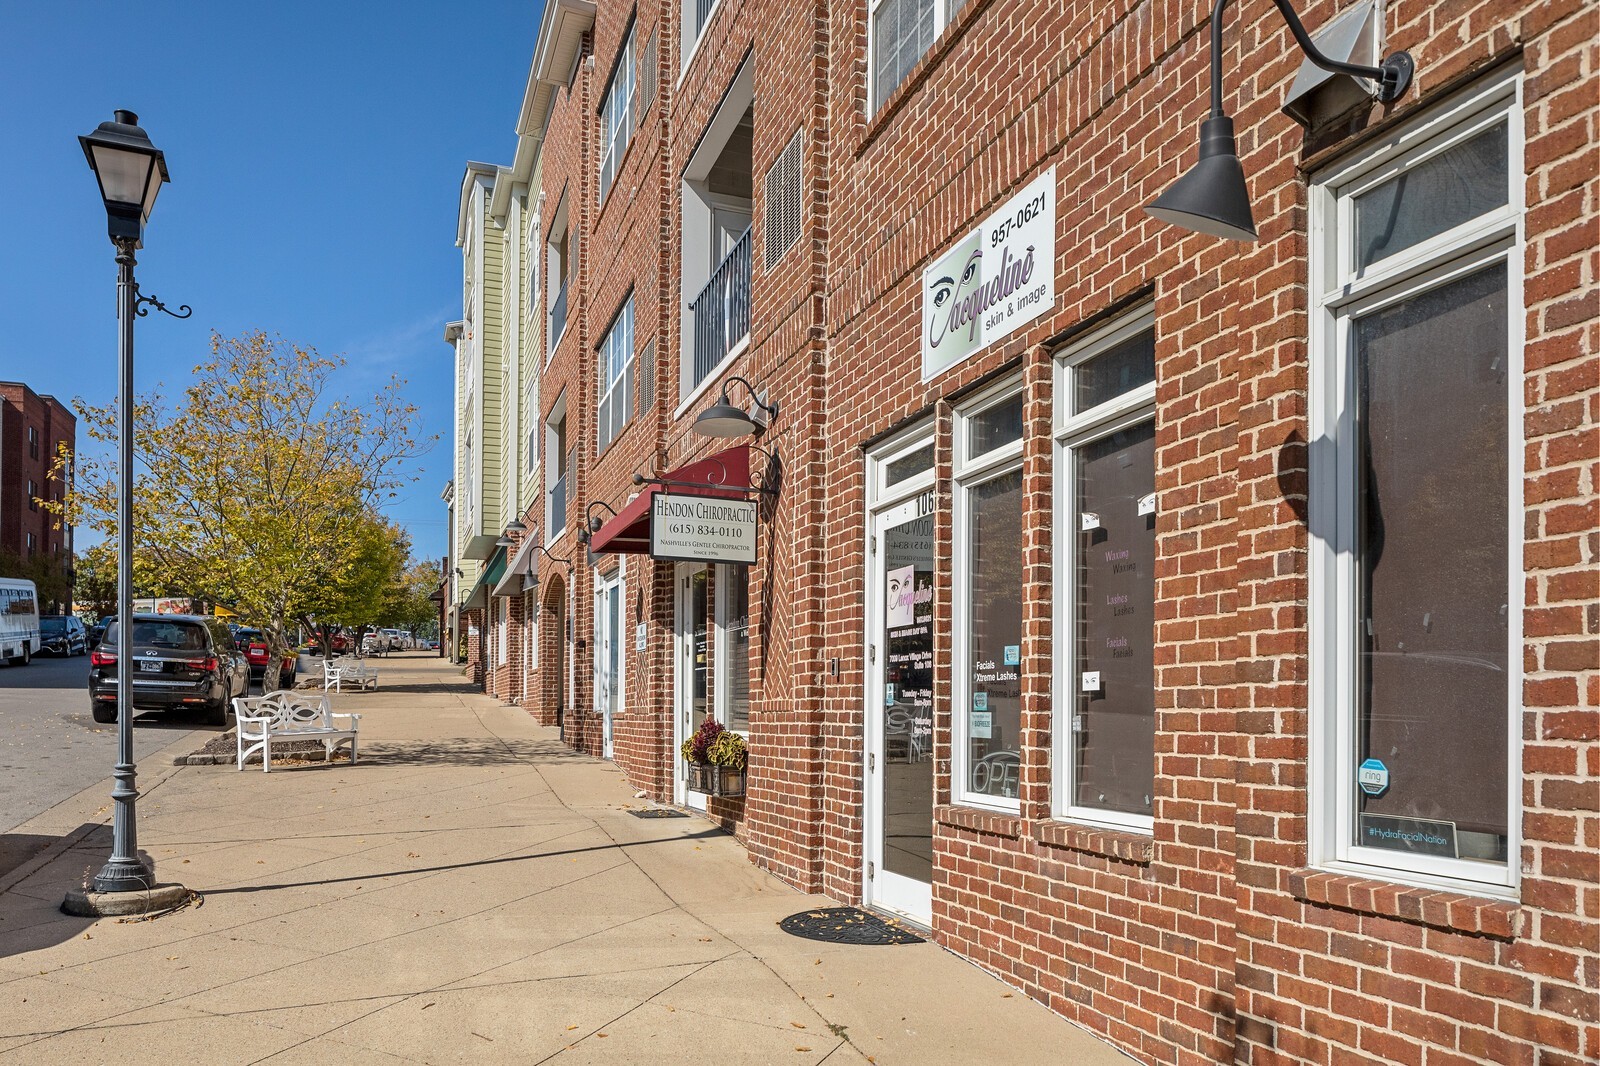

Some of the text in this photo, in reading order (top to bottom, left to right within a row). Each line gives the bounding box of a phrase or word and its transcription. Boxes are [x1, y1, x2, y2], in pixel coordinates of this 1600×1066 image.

[992, 192, 1046, 248] 957-0621
[986, 284, 1046, 331] skin & image
[916, 490, 934, 517] 106
[656, 499, 755, 523] HENDON CHIROPRACTIC
[669, 524, 742, 538] (615) 834-0110
[1105, 550, 1129, 562] Waxing
[1106, 594, 1128, 605] Lashes
[1106, 636, 1127, 648] Facials
[976, 660, 995, 670] Facials
[976, 671, 1017, 682] Xtreme Lashes
[973, 761, 1020, 798] OPE
[1365, 770, 1381, 783] ring
[1369, 828, 1447, 845] #HydraFacialNation
